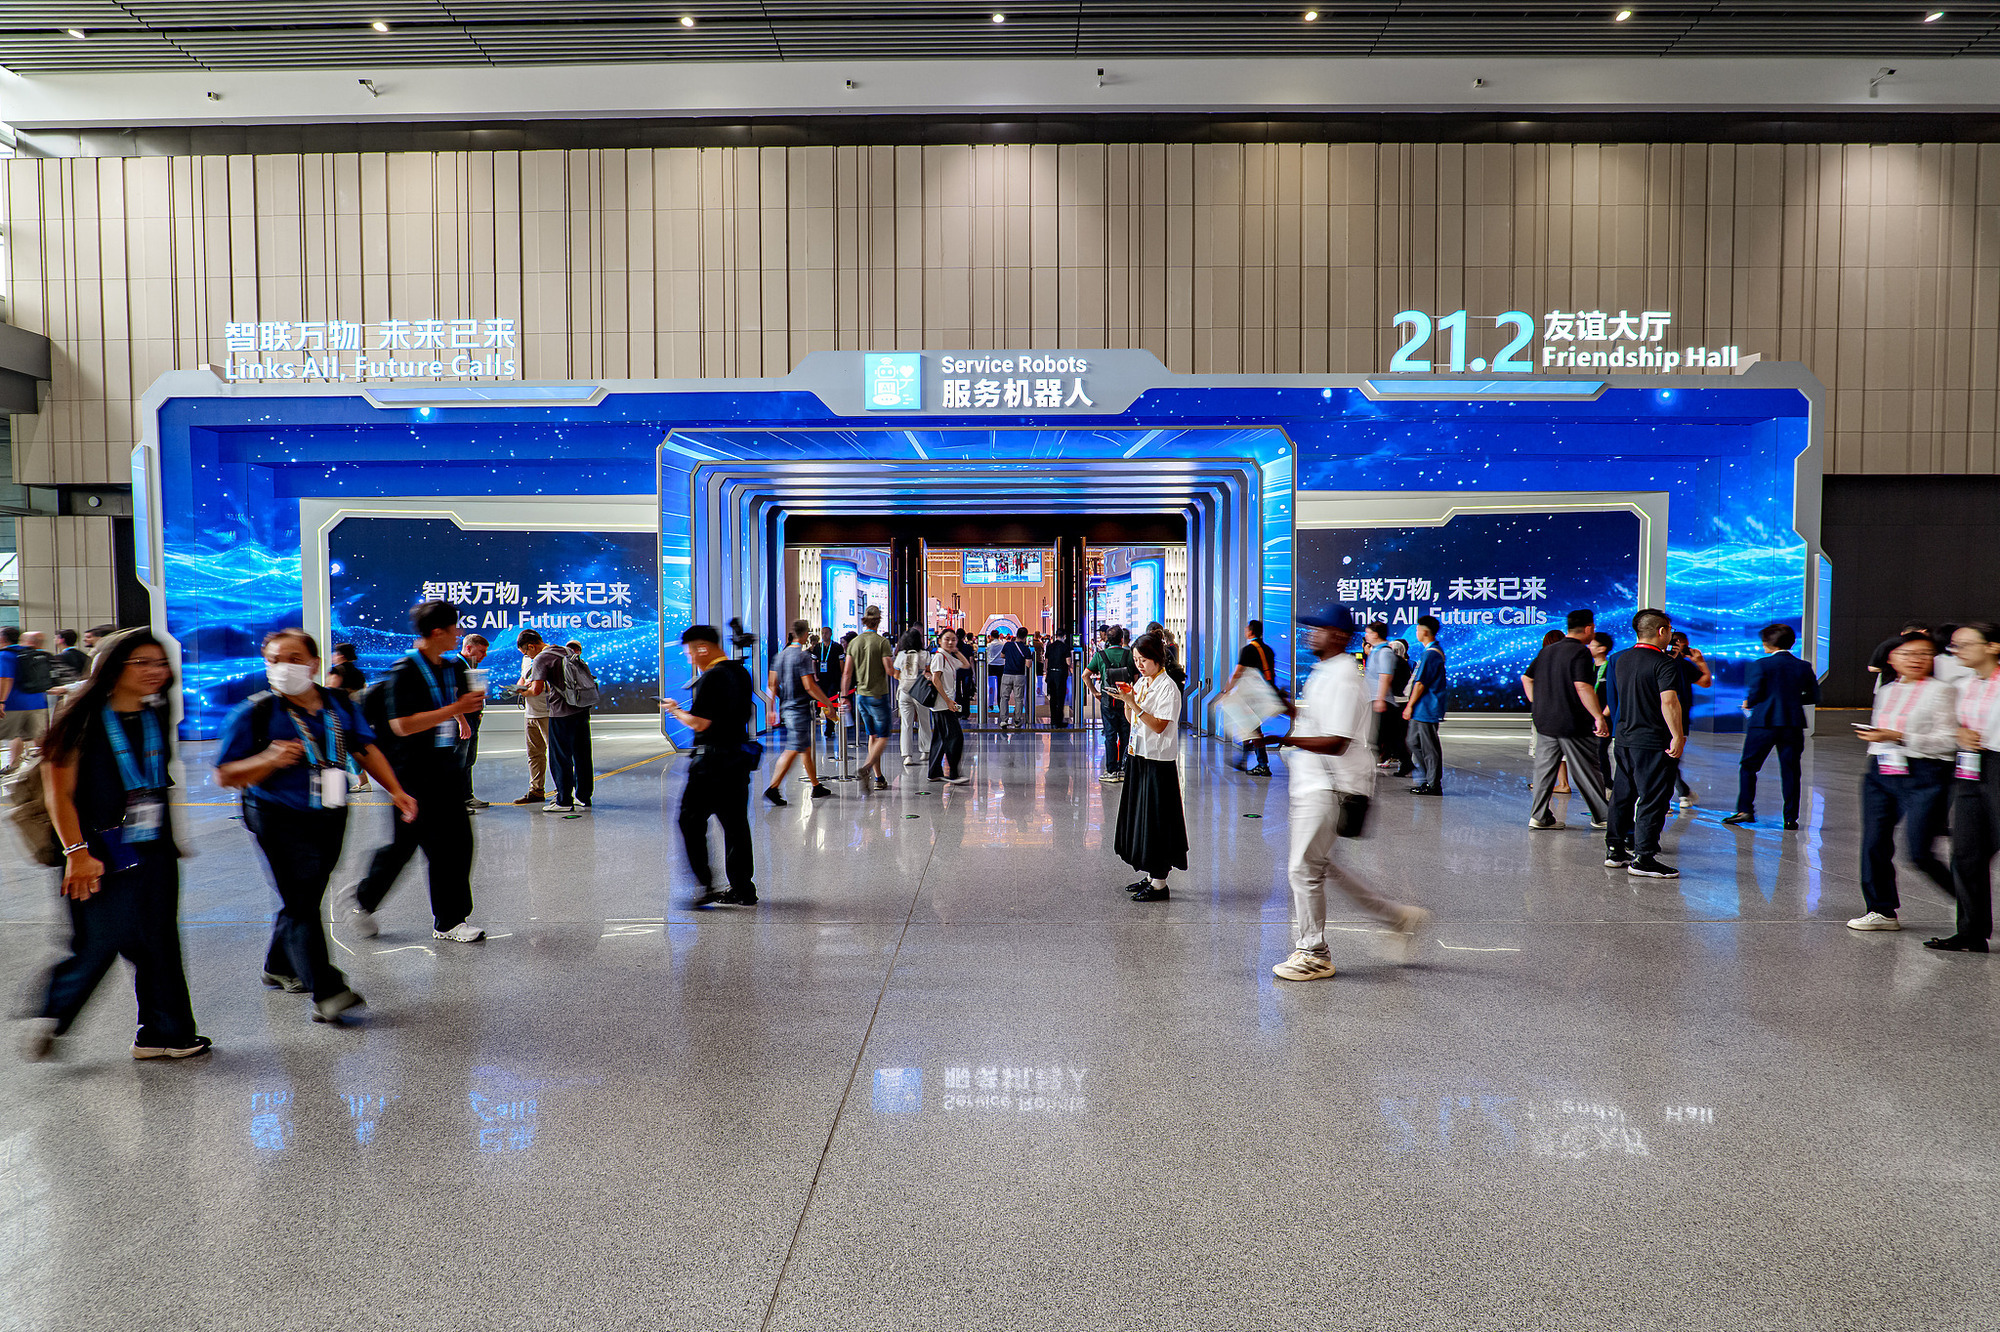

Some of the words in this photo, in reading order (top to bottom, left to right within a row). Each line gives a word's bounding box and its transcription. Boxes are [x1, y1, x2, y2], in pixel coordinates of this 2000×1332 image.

[225, 320, 361, 352] 智联万物
[379, 318, 516, 350] 未来已来
[1543, 310, 1672, 342] 友谊大厅
[1390, 309, 1535, 373] 21.2
[225, 357, 295, 380] Links
[302, 356, 346, 381] All,
[355, 355, 443, 378] Future
[451, 353, 516, 377] Calls
[941, 355, 1014, 374] Service
[1018, 355, 1087, 374] Robots
[1542, 346, 1681, 372] Friendship
[1686, 346, 1738, 368] Hall
[942, 377, 1094, 408] 服务机器人
[482, 610, 513, 631] All,
[519, 611, 582, 629] Future
[586, 610, 633, 629] Calls
[1349, 607, 1389, 625] inks
[1430, 606, 1494, 625] Future
[1498, 606, 1548, 625] Calls
